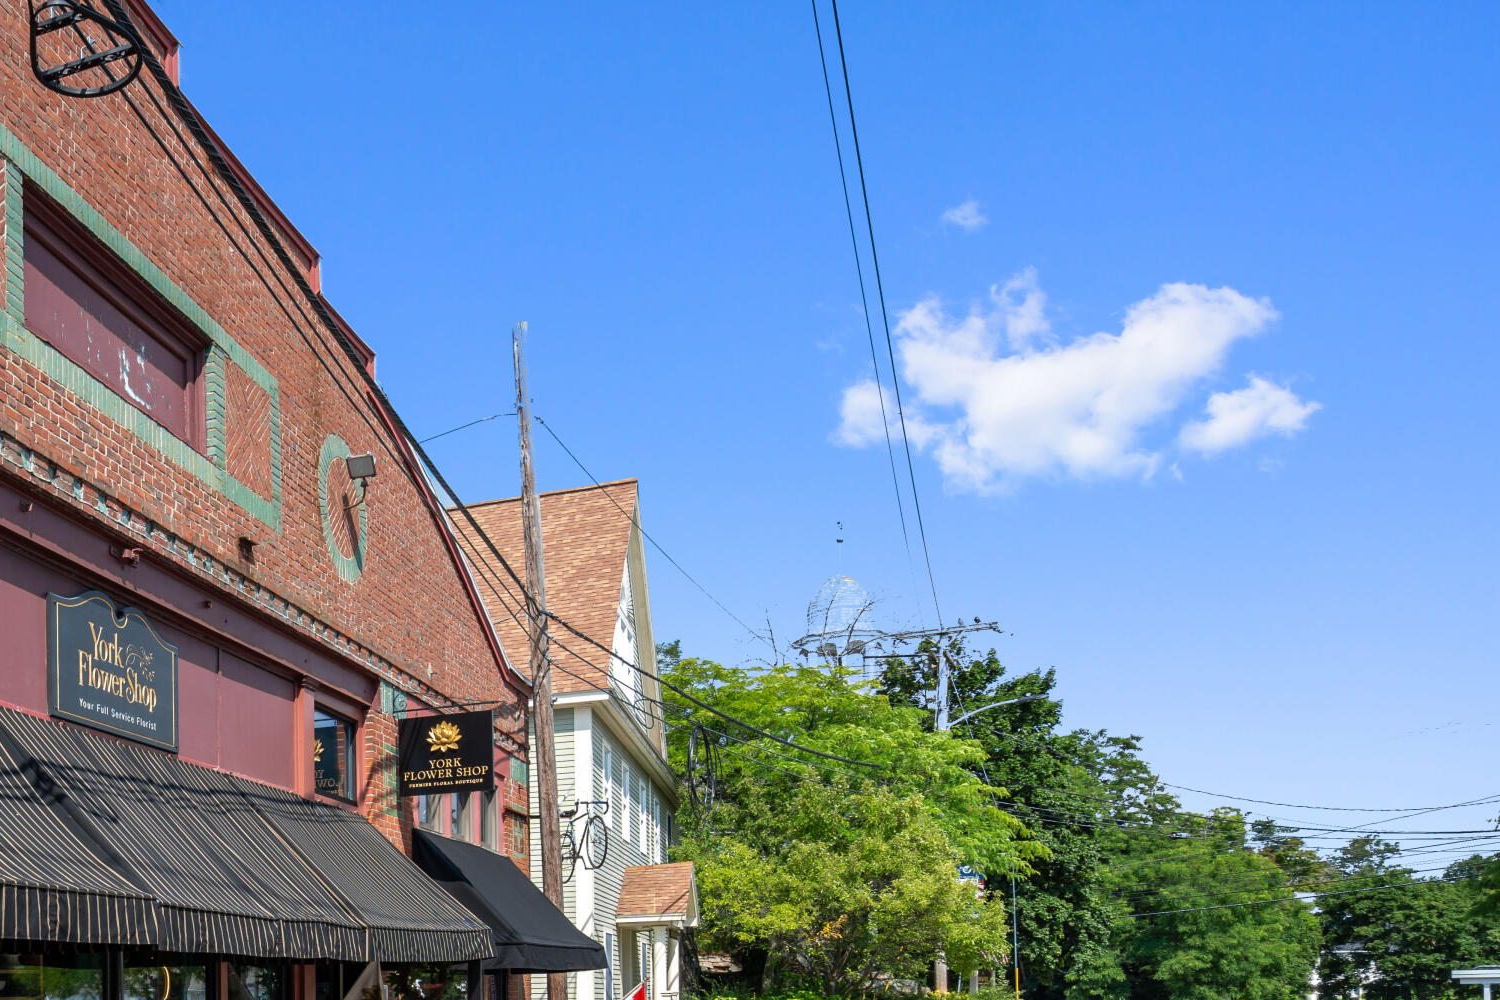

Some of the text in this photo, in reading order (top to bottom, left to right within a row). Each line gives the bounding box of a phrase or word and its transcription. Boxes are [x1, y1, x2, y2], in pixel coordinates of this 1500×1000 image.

[88, 621, 124, 669] York
[78, 650, 157, 713] Flower Shop
[79, 697, 157, 731] Your Full Service Florist
[403, 765, 489, 781] FLOWER SHOP
[429, 757, 462, 769] YORK
